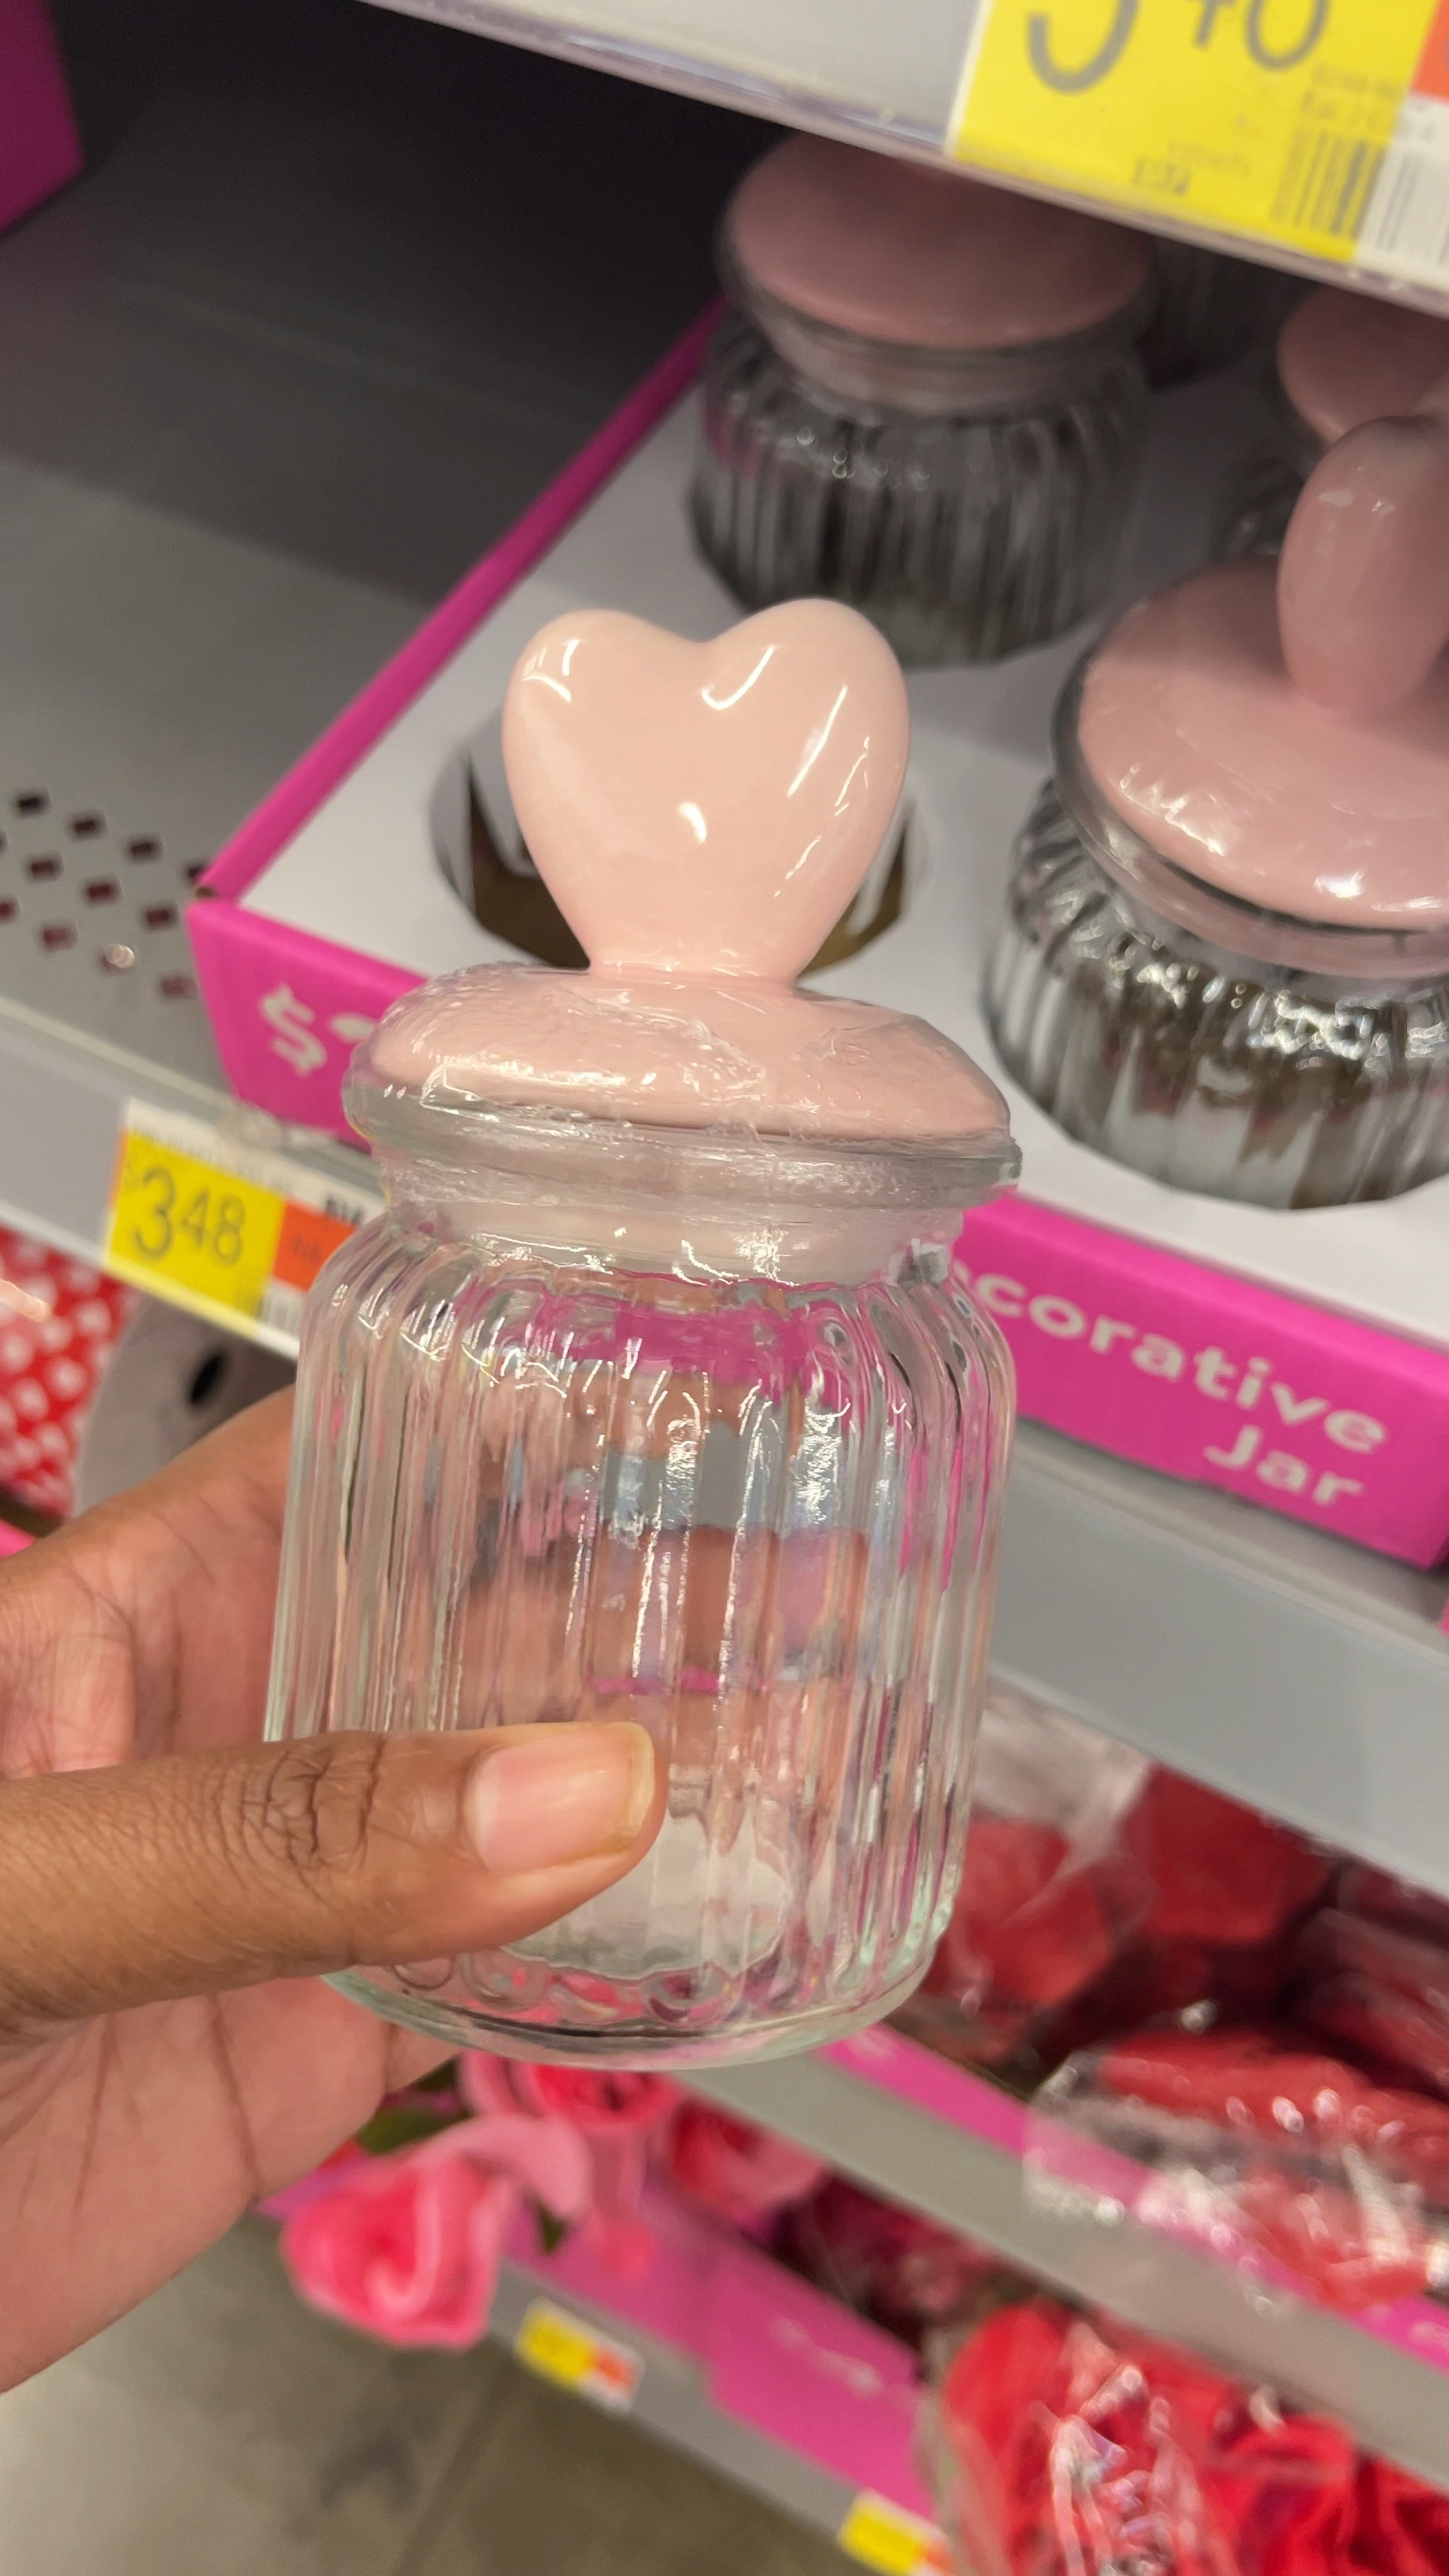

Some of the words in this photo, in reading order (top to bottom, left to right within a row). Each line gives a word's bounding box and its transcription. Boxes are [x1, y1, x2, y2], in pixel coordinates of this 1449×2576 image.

[133, 1165, 246, 1265] 348
[953, 1260, 1387, 1453] corative
[1205, 1425, 1364, 1507] Jar
